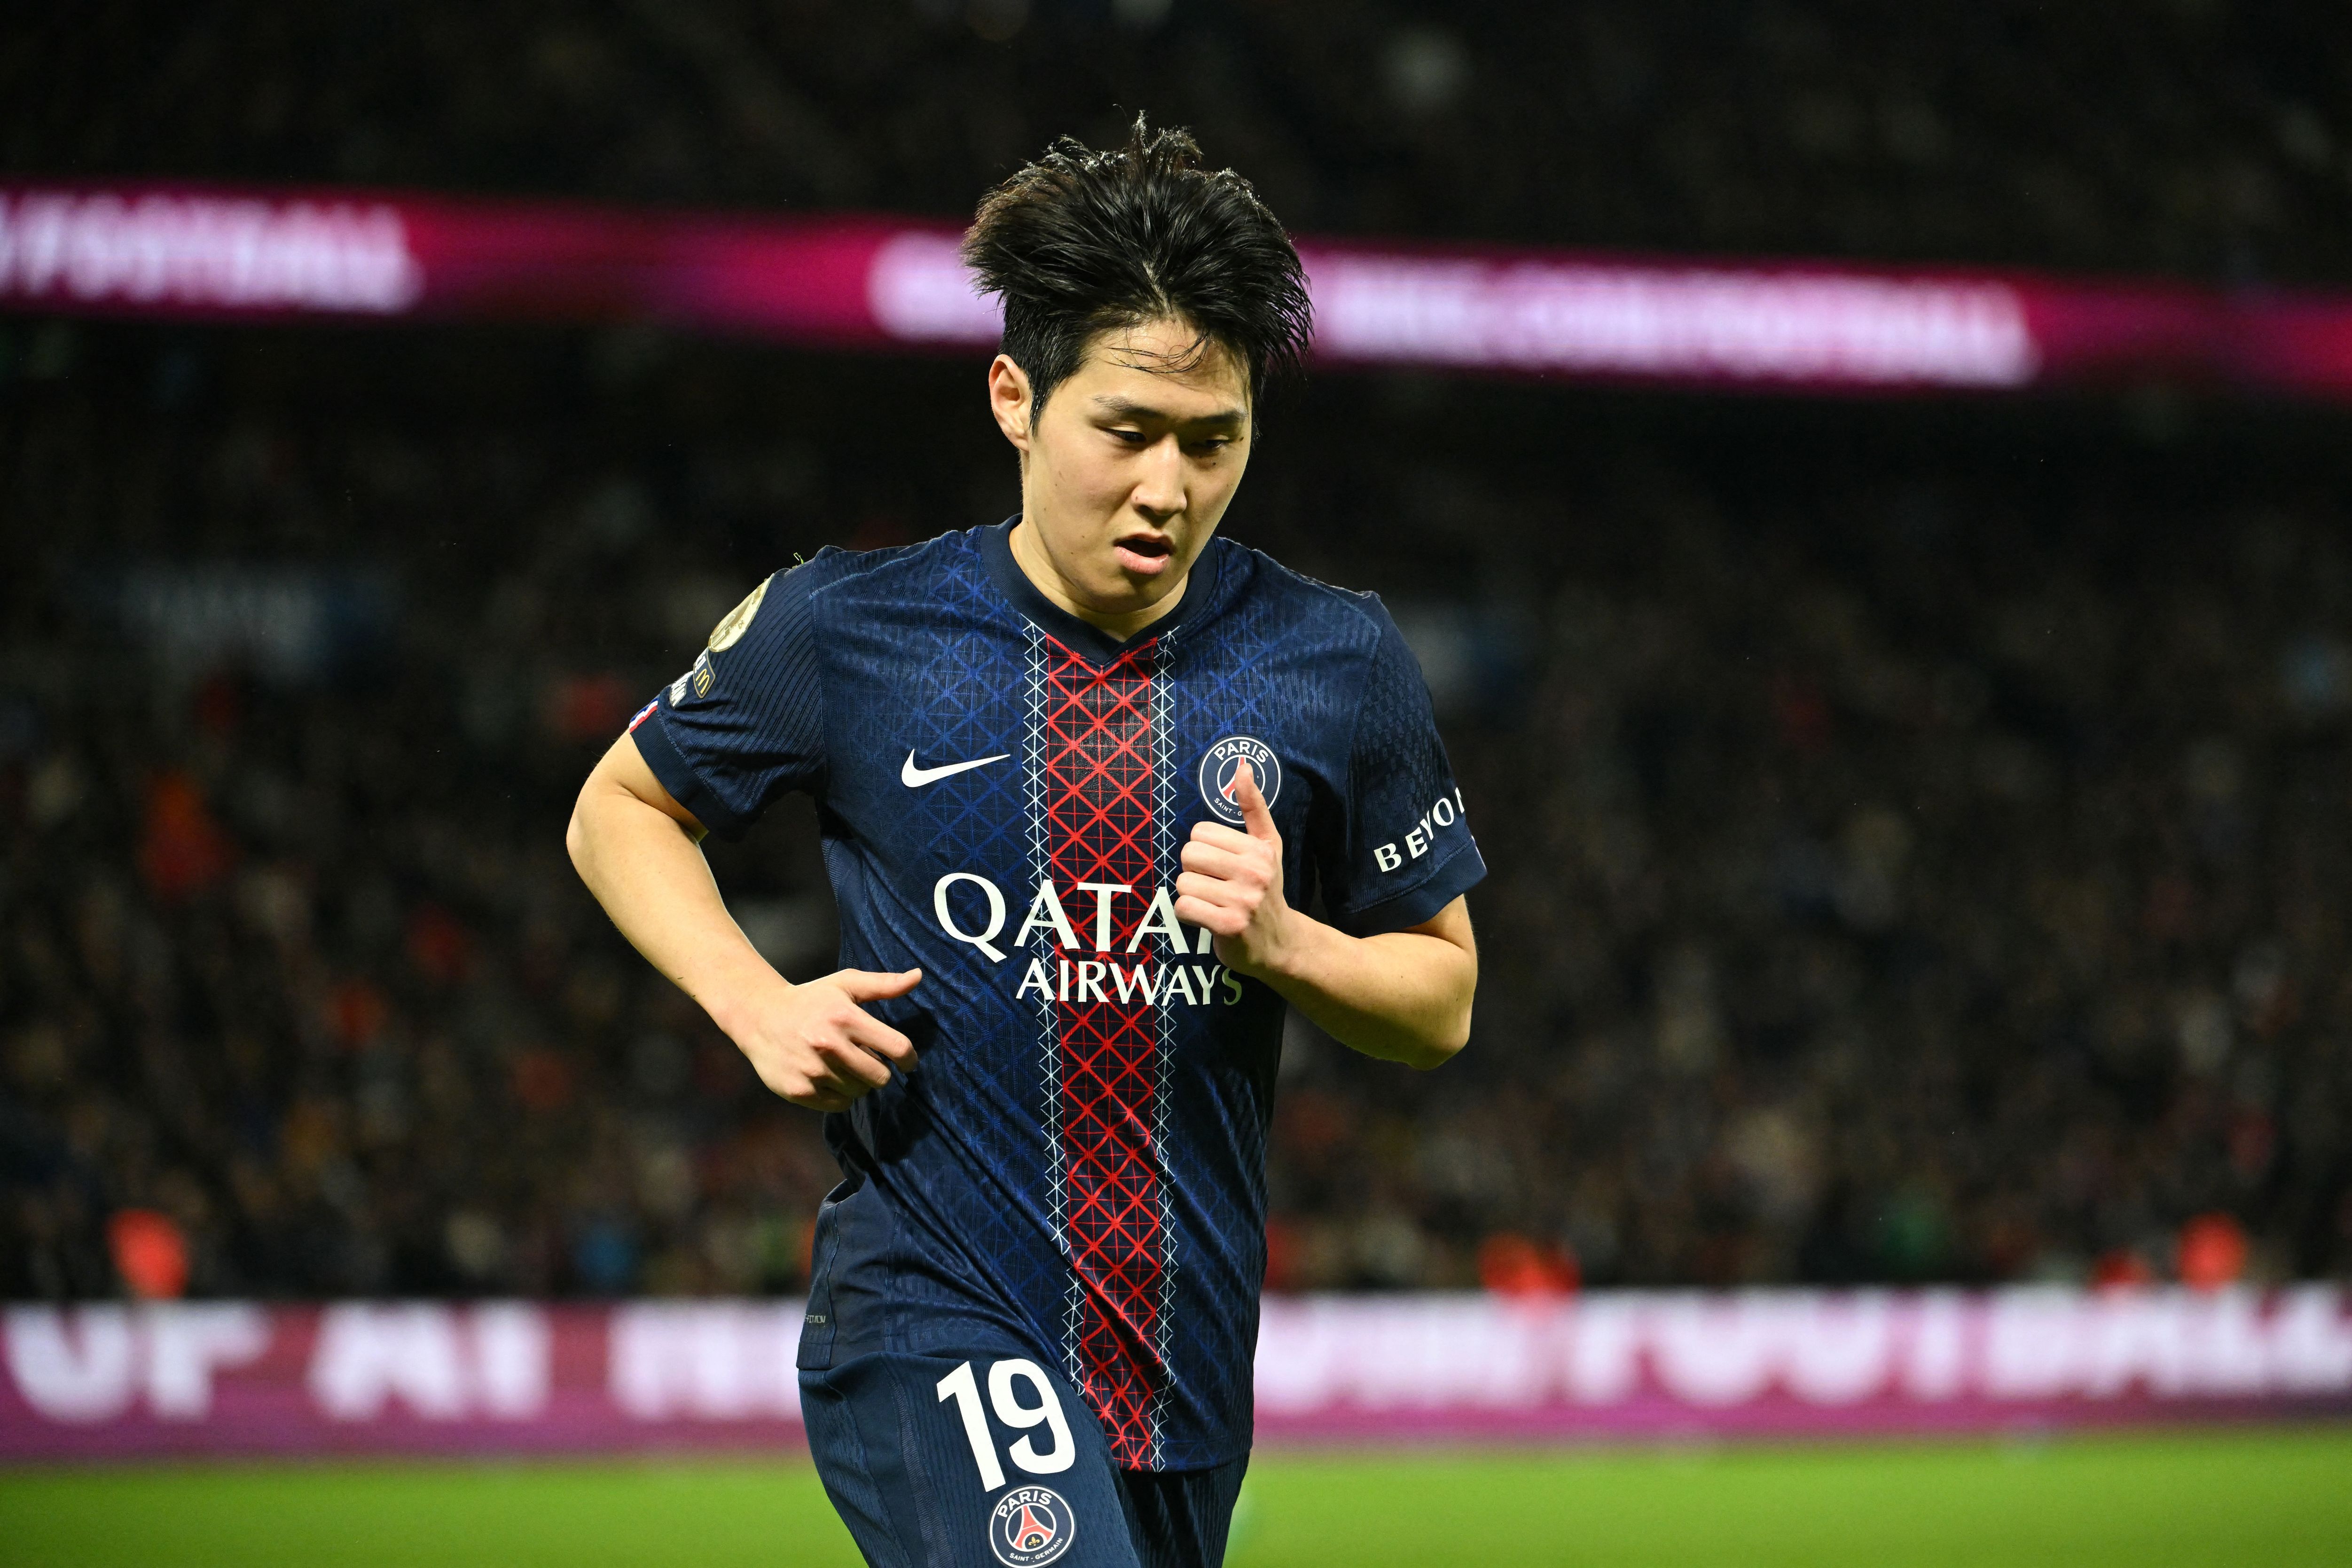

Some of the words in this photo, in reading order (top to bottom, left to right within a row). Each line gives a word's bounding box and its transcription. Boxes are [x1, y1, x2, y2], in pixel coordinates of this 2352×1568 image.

[1214, 741, 1269, 763] PARIS
[934, 872, 1214, 963] QATA
[1016, 957, 1243, 1006] AIRWAYS
[936, 1358, 1075, 1492] 19
[997, 1490, 1052, 1518] PARIS
